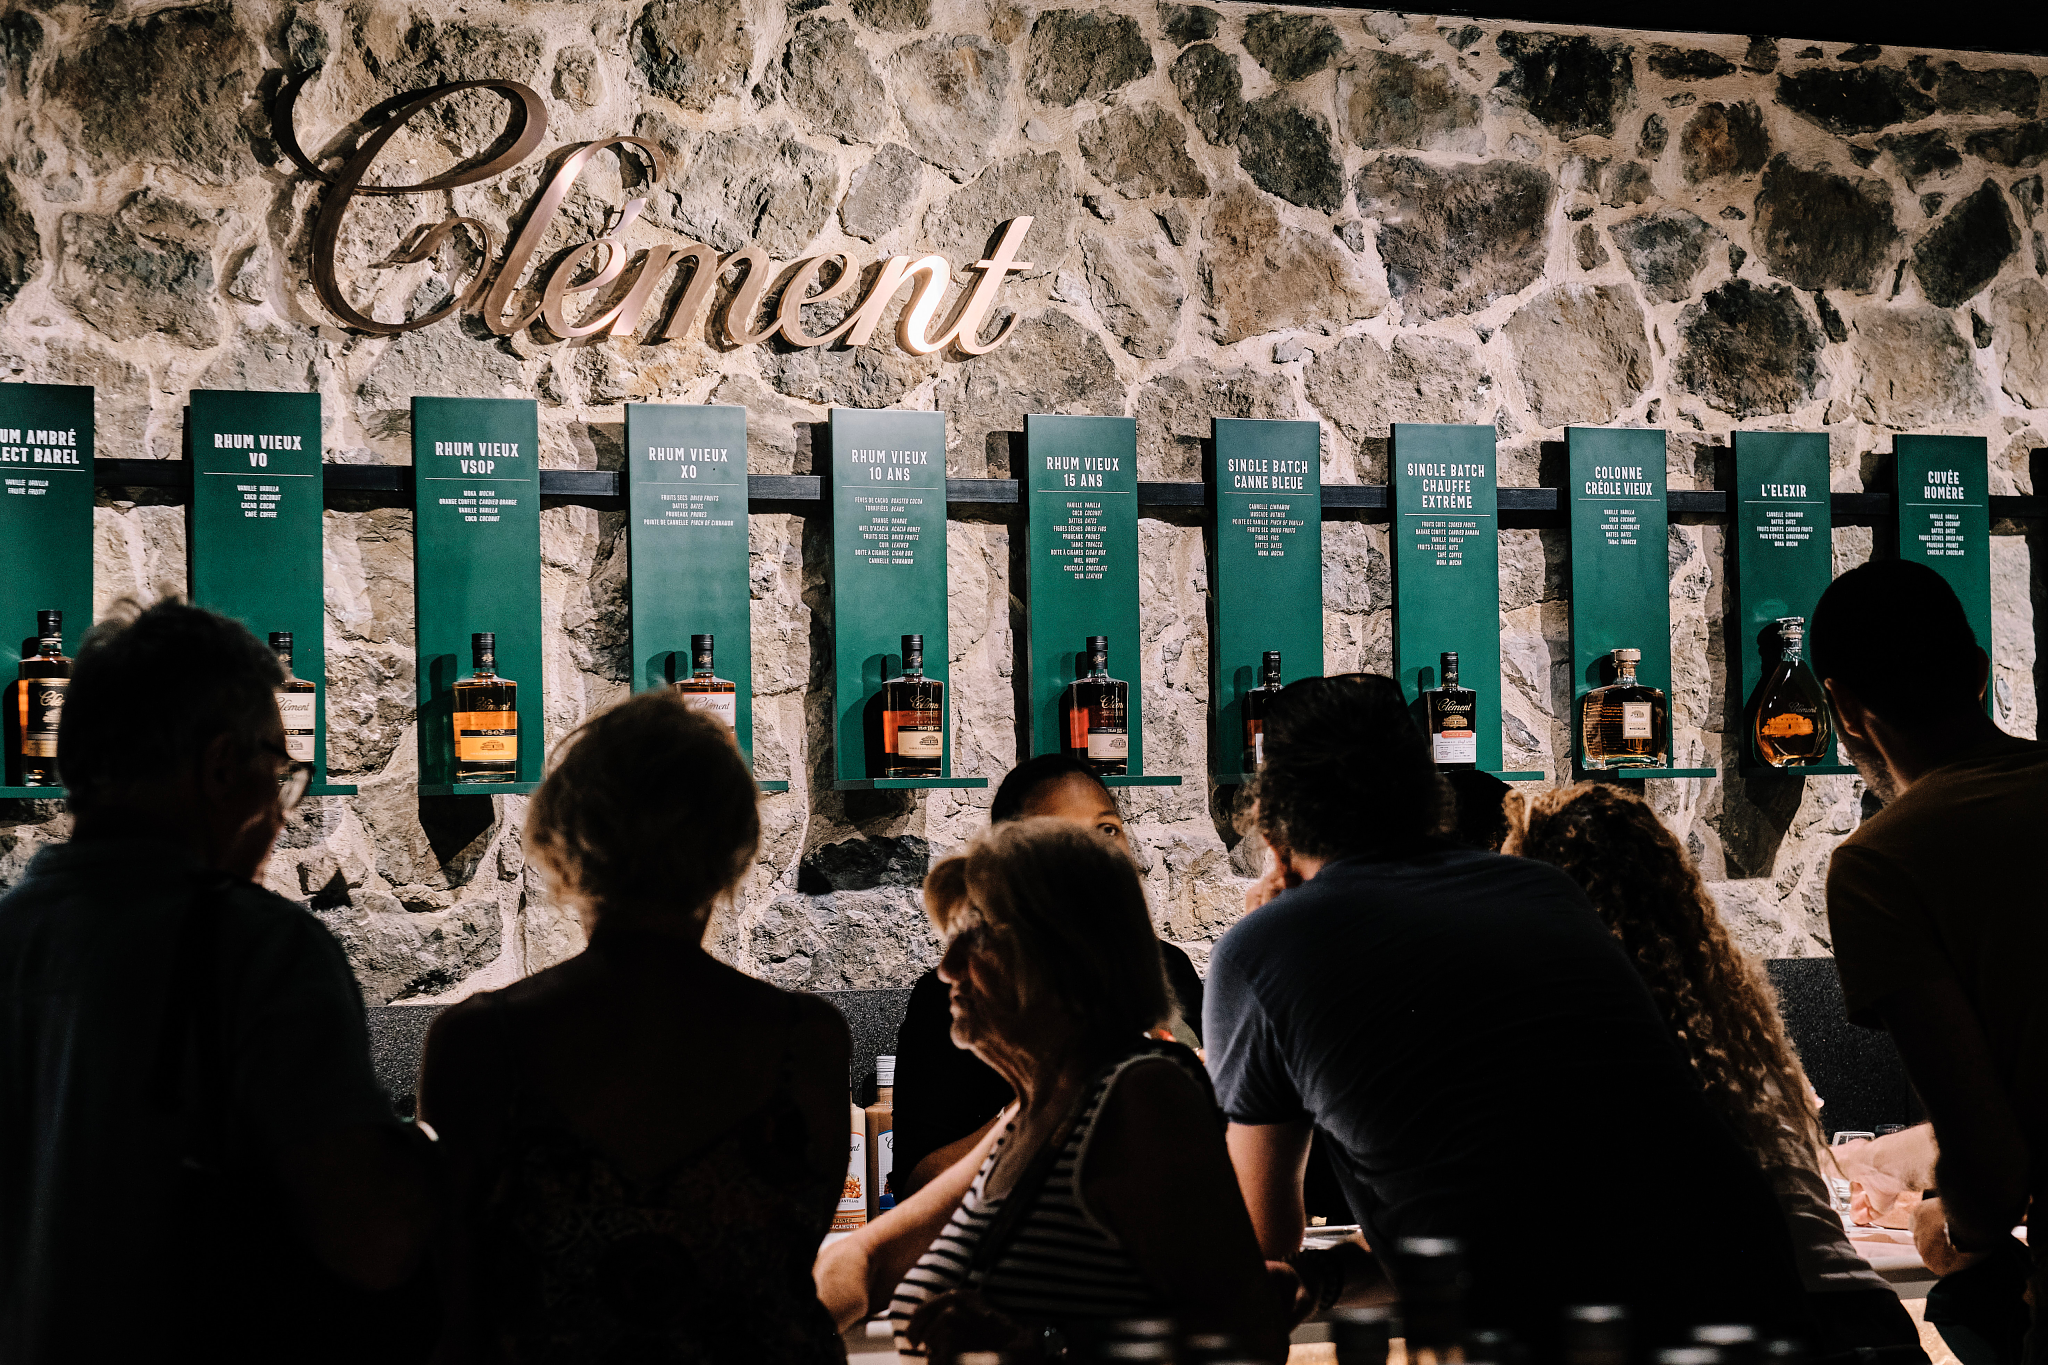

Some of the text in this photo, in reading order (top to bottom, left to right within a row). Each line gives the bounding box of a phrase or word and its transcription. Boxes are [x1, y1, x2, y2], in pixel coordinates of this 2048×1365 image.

[274, 69, 1034, 356] Clément
[26, 428, 76, 446] AMBRÉ
[214, 434, 302, 450] RHUM VIEUX
[0, 446, 79, 464] ECT BAREL
[436, 442, 519, 457] RHUM VIEUX
[649, 447, 728, 462] RHUM VIEUX
[249, 453, 267, 467] VO
[852, 450, 927, 464] RHUM VIEUX
[1047, 457, 1119, 471] RHUM VIEUX
[460, 460, 494, 474] VSOP
[681, 465, 696, 478] XO
[1228, 459, 1308, 473] SINGLE BATCH
[1408, 463, 1485, 477] SINGLE BATCH
[1595, 466, 1642, 479] COLONNE
[869, 467, 910, 481] 10 ANS
[1064, 474, 1102, 487] 15 ANS
[1928, 469, 1959, 484] CUVÉE
[1234, 475, 1303, 489] CANNE BLEUE
[1423, 479, 1470, 492] CHAUFFE
[1586, 480, 1652, 495] CRÉOLE VIEUX
[1762, 484, 1806, 497] L'ELEXIR
[1924, 484, 1964, 499] HOMÈRE
[1422, 493, 1472, 508] EXTRÊME
[1436, 698, 1472, 711] Clément
